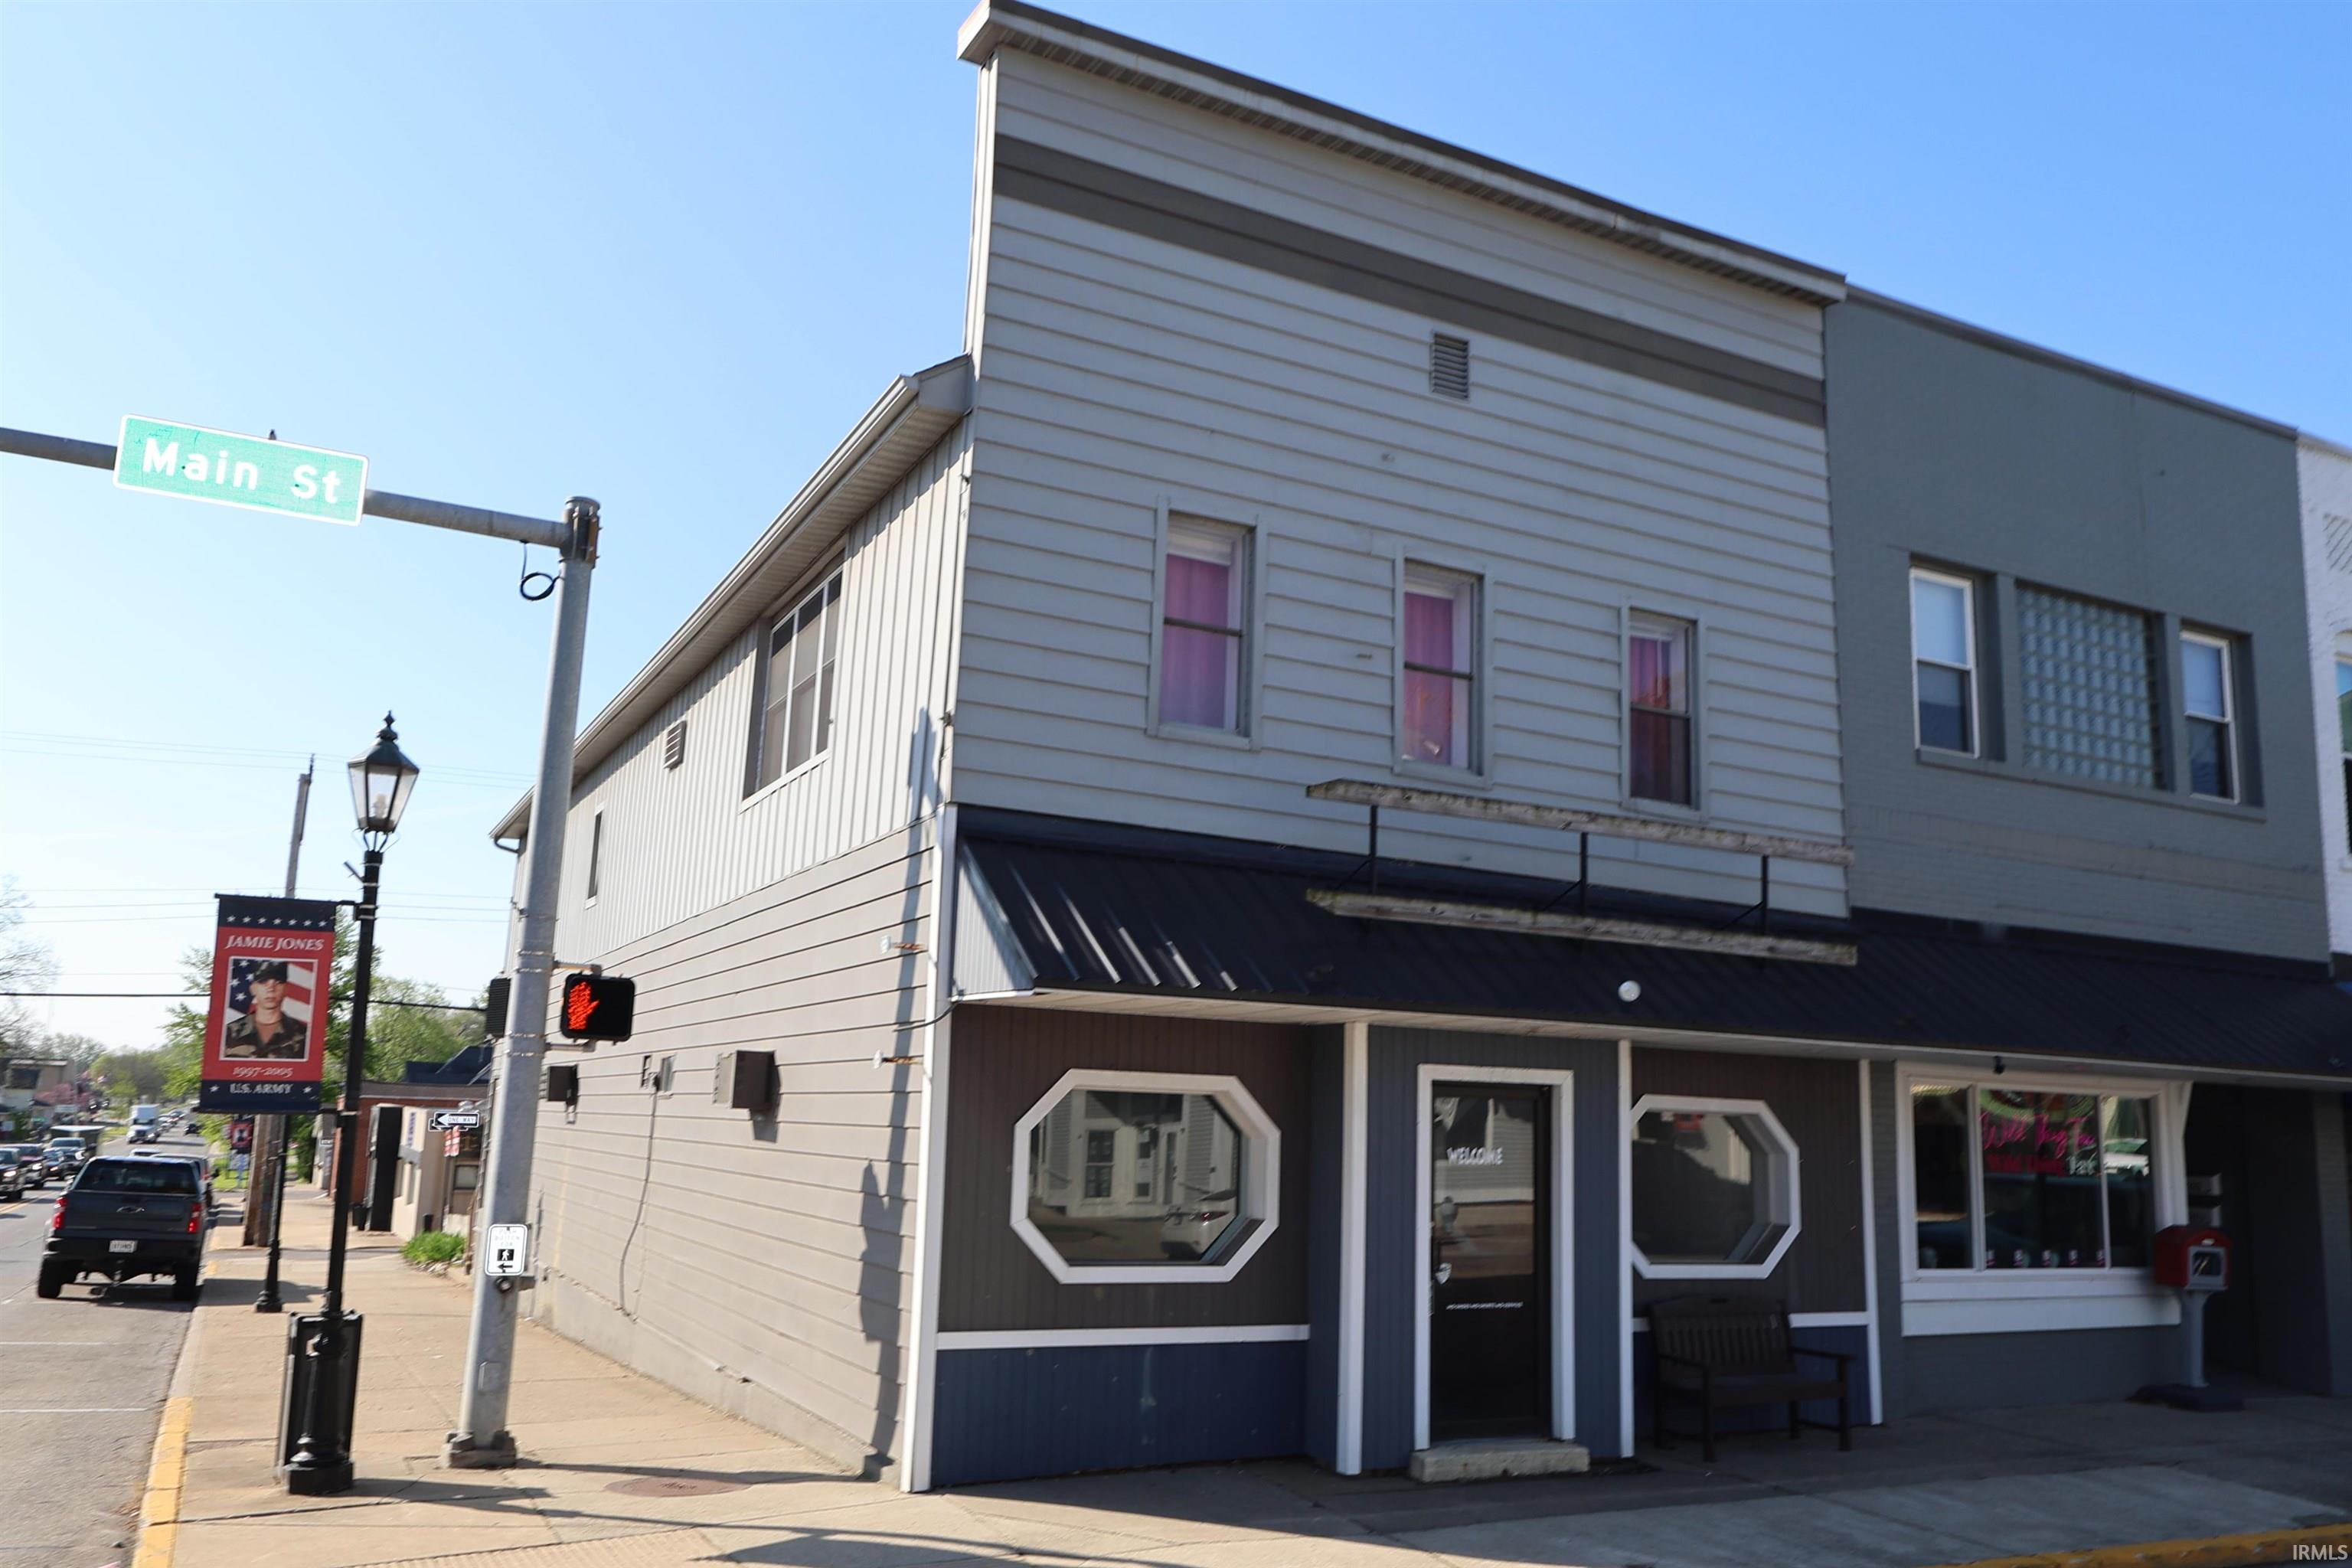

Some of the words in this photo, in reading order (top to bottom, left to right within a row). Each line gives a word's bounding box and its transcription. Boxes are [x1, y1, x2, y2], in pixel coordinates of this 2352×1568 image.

[142, 437, 258, 490] Main
[290, 464, 341, 504] St
[224, 935, 276, 949] JAMIE
[274, 938, 325, 951] JONES
[233, 1067, 293, 1078] 1997-2005
[230, 1083, 252, 1093] U.S.
[253, 1083, 293, 1093] ARMY
[1446, 1147, 1503, 1165] WELCOME
